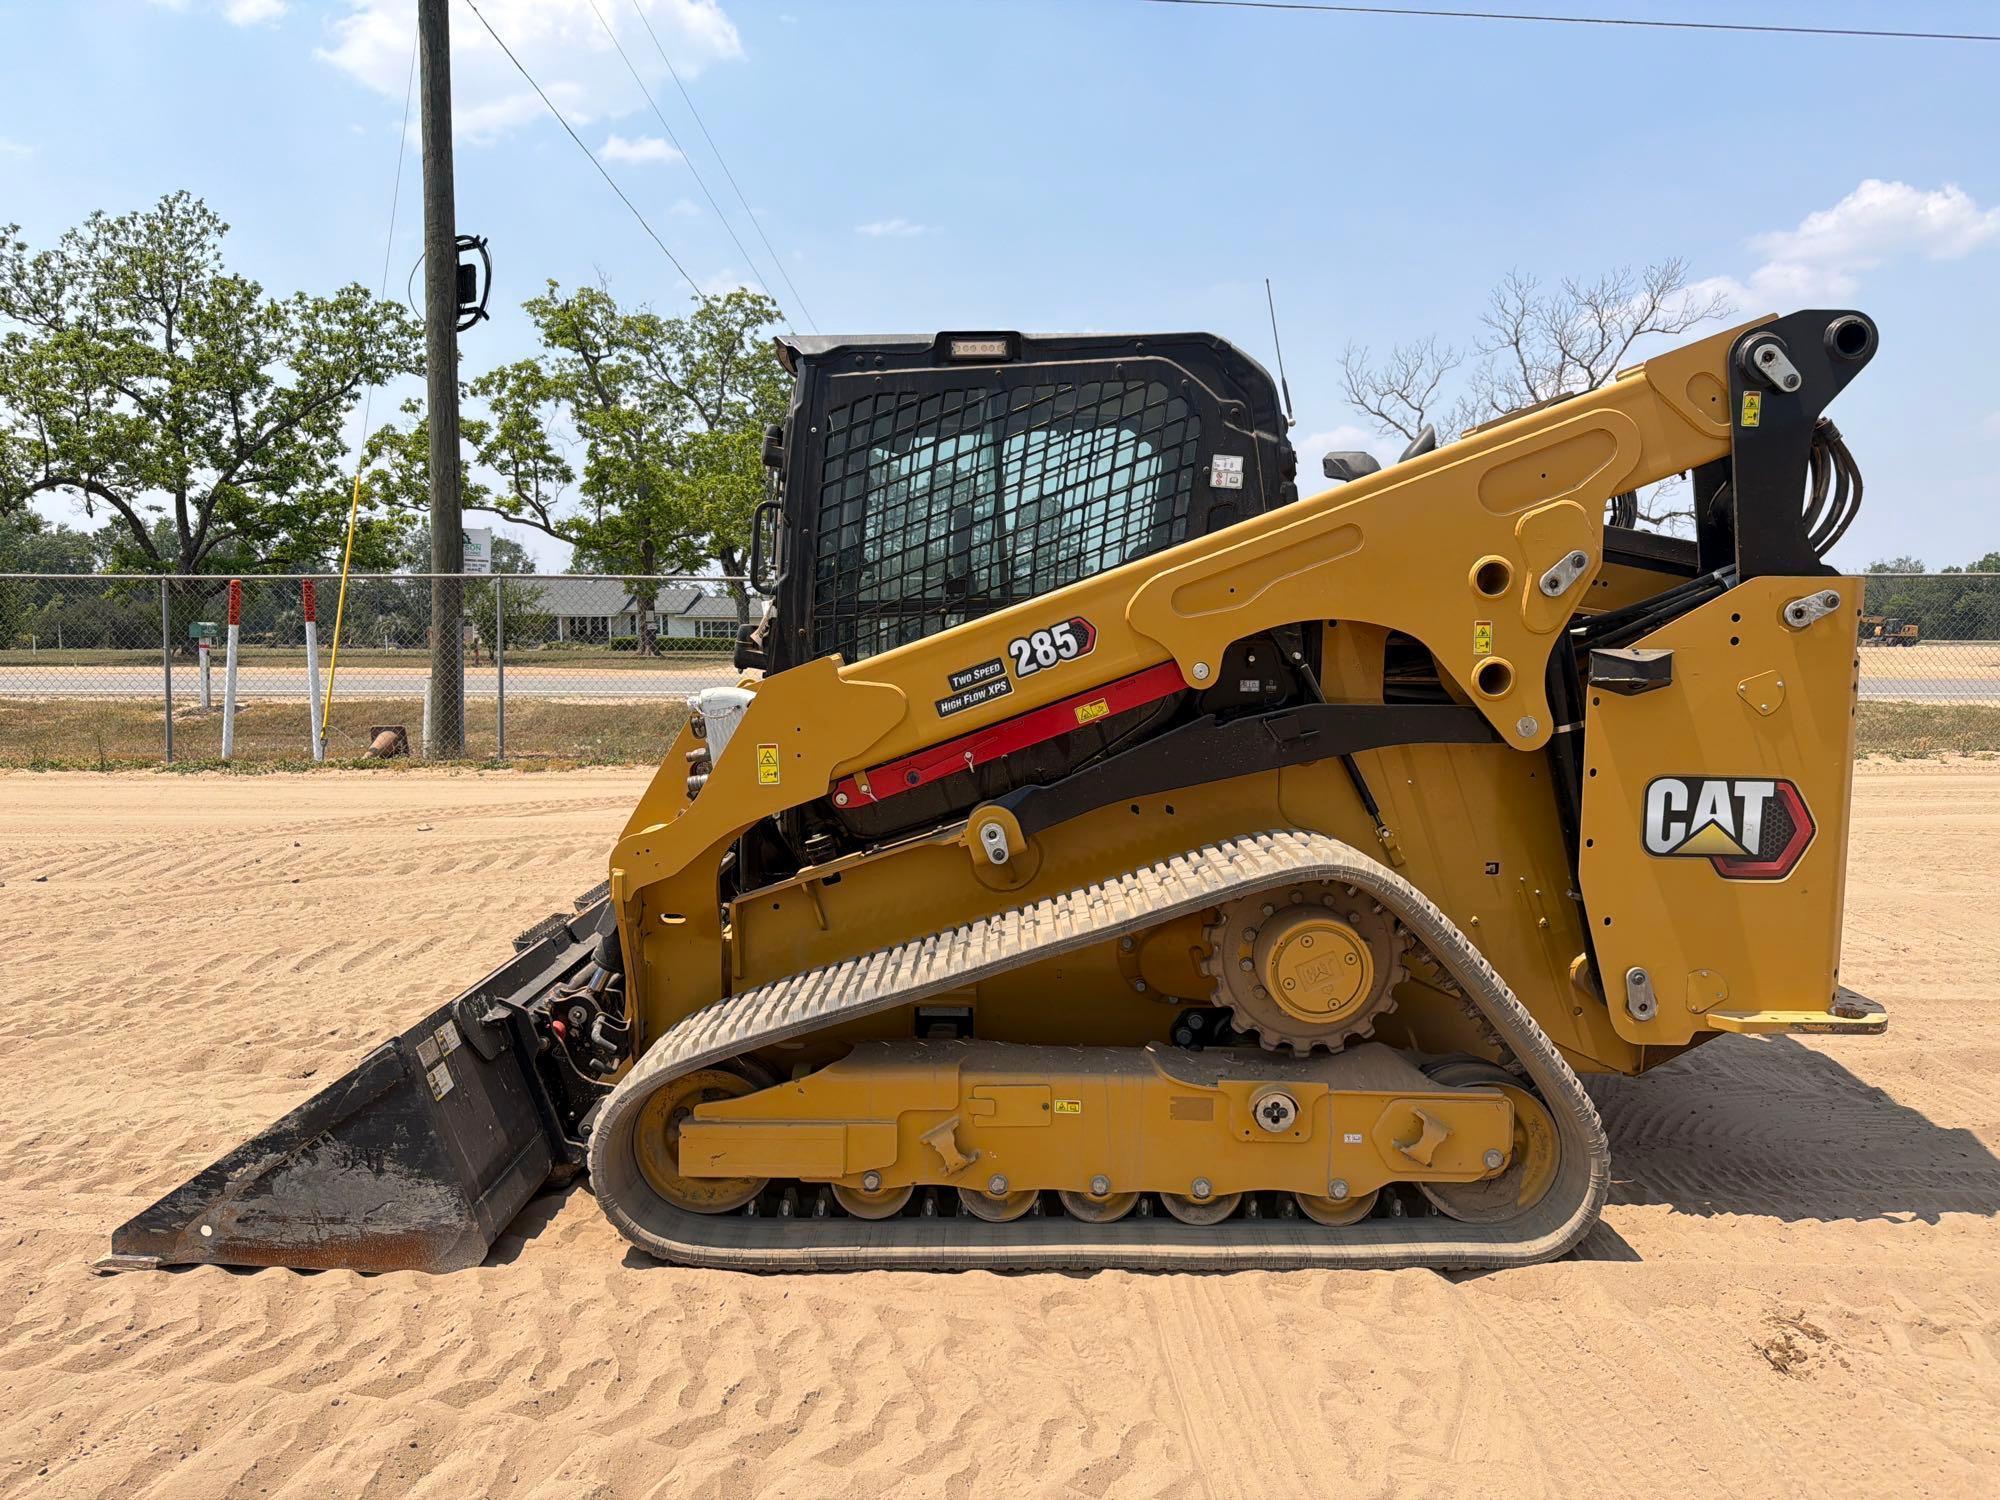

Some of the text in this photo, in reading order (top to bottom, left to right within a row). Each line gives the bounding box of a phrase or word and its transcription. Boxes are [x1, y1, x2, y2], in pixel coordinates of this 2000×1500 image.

[1009, 622, 1078, 676] 285
[952, 663, 1001, 688] TWO SPEED
[941, 681, 1007, 714] HIGH FLOW XPS
[1646, 779, 1774, 855] CAT
